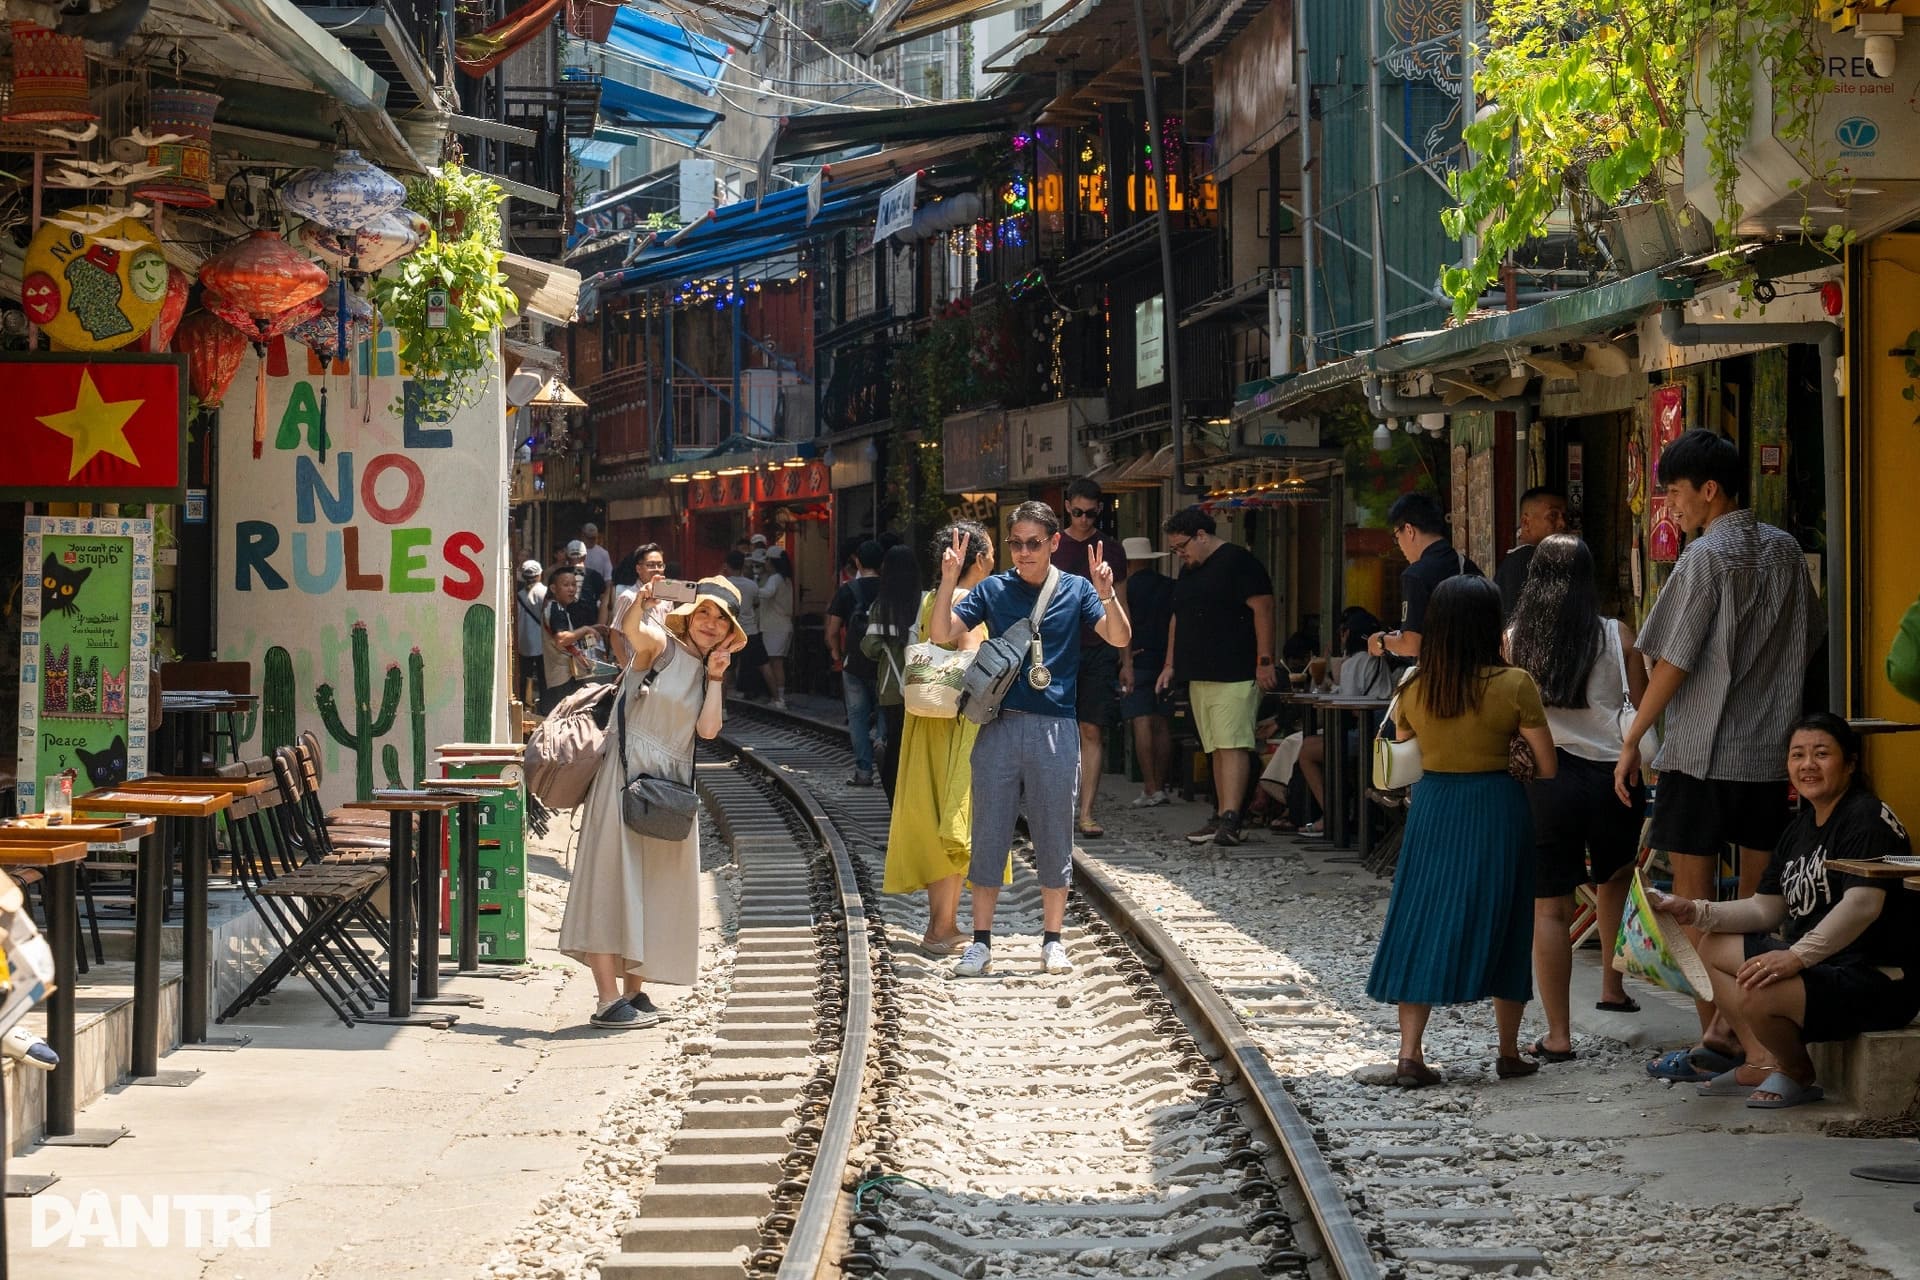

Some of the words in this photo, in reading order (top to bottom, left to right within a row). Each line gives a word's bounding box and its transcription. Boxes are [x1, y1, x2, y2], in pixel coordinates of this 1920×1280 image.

[1860, 83, 1894, 95] panel
[50, 231, 84, 263] NO
[296, 452, 425, 524] NO
[68, 543, 86, 552] You
[109, 543, 124, 554] fix
[235, 520, 485, 601] RULES
[42, 732, 88, 752] Peace
